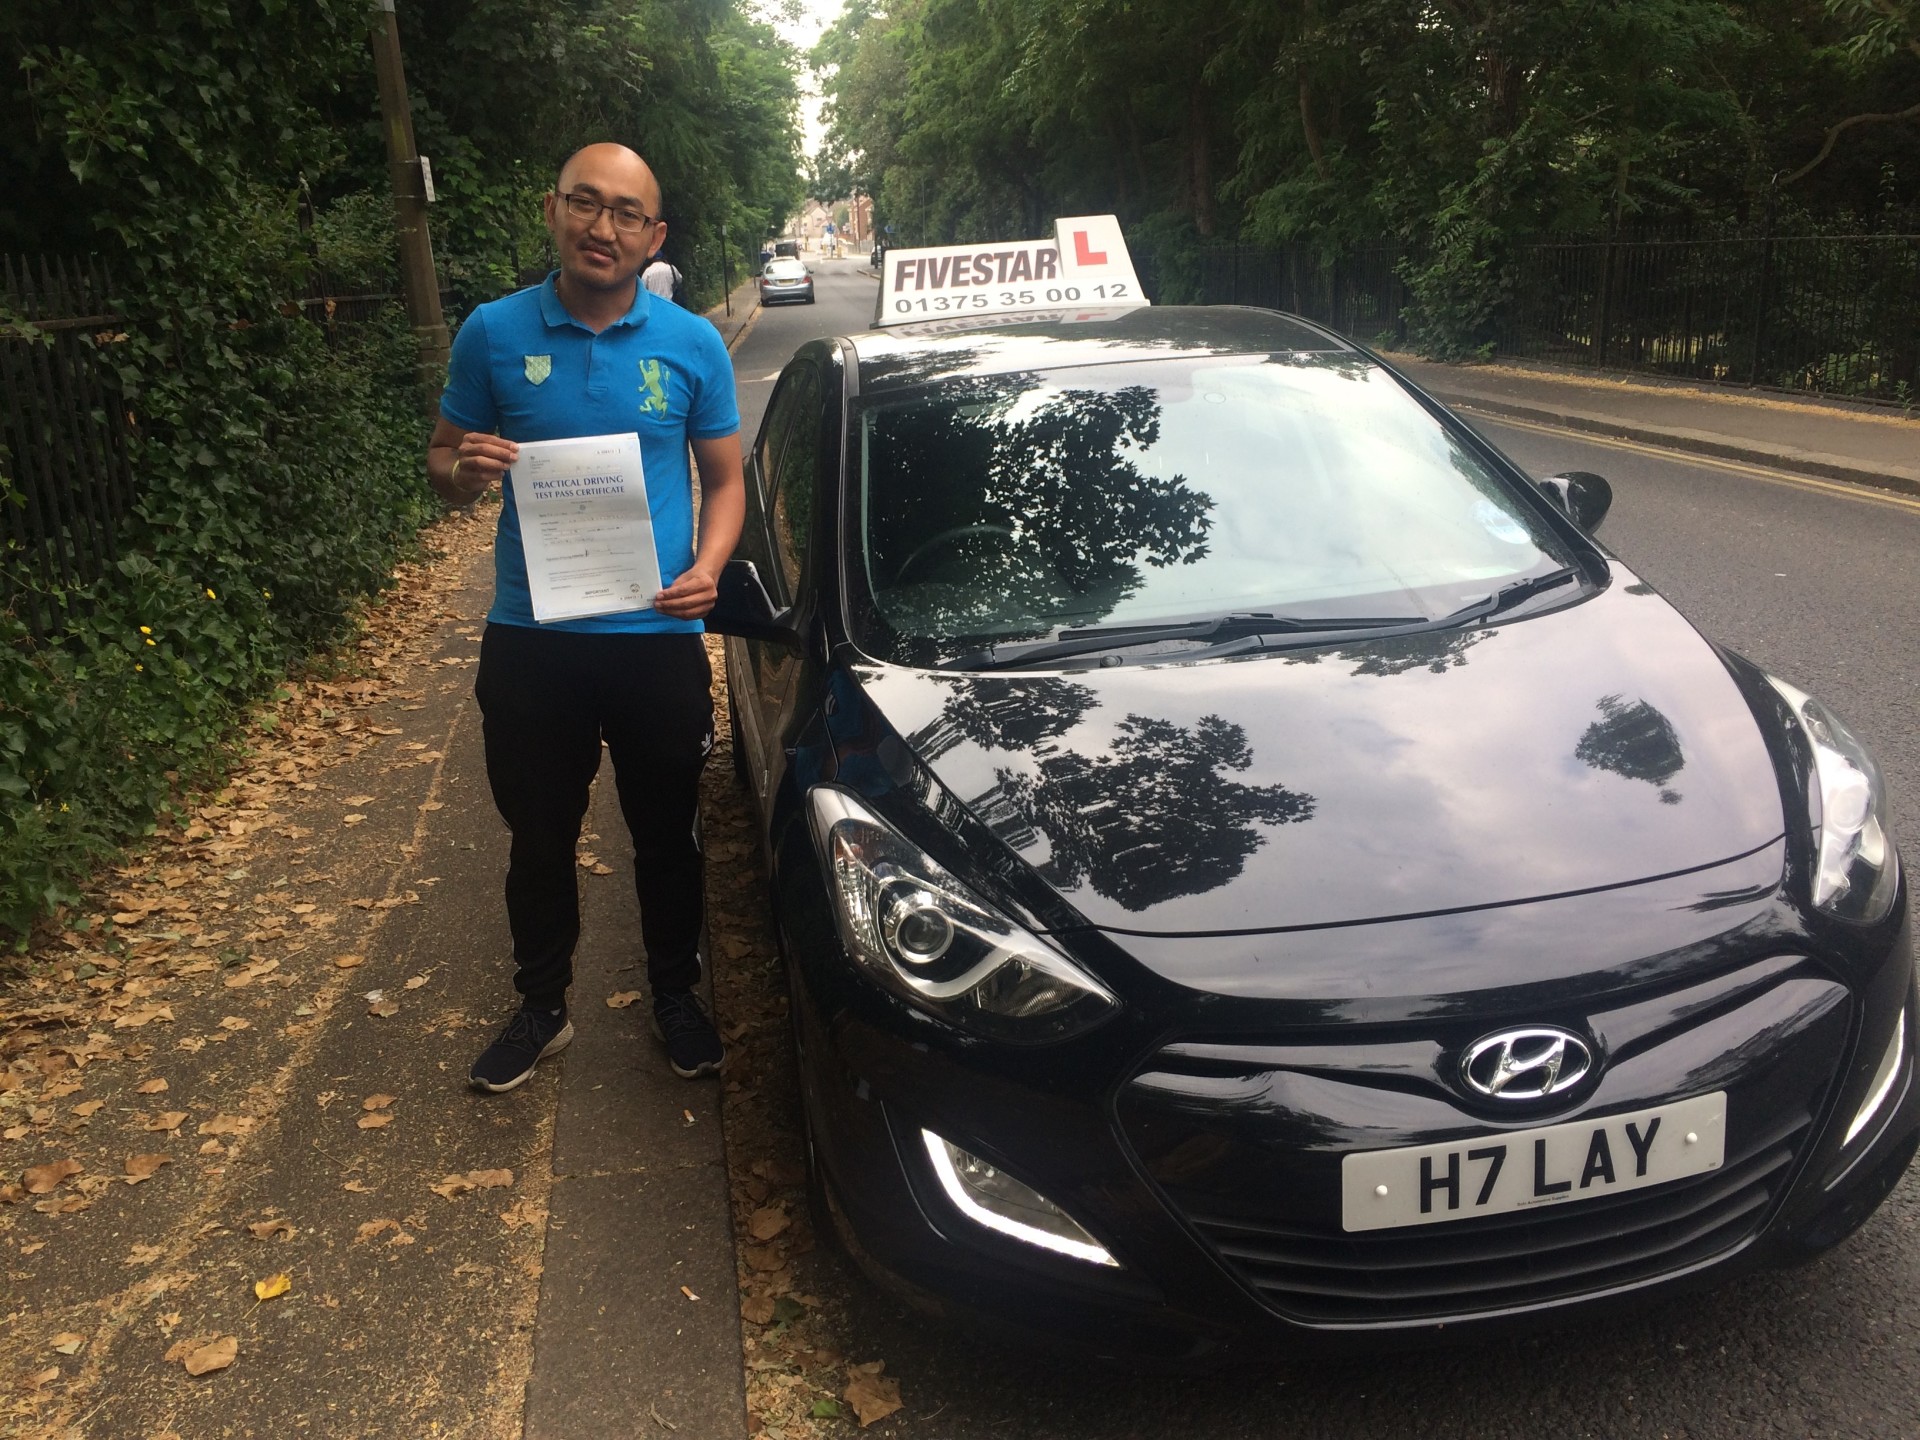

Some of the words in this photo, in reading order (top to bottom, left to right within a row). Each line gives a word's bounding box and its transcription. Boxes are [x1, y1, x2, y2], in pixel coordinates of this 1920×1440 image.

[1072, 230, 1108, 267] L
[894, 248, 1059, 293] FIVESTAR
[895, 294, 989, 314] 01375
[1000, 290, 1036, 306] 35
[1046, 286, 1081, 302] 00
[1093, 283, 1128, 298] 12
[533, 479, 581, 490] PRACTICAL
[584, 475, 624, 486] DRIVING
[535, 491, 553, 500] TEST
[555, 490, 574, 498] PASS
[576, 486, 625, 496] CERTIFICATE
[1420, 1145, 1507, 1214] H7
[1534, 1117, 1662, 1198] LAY
